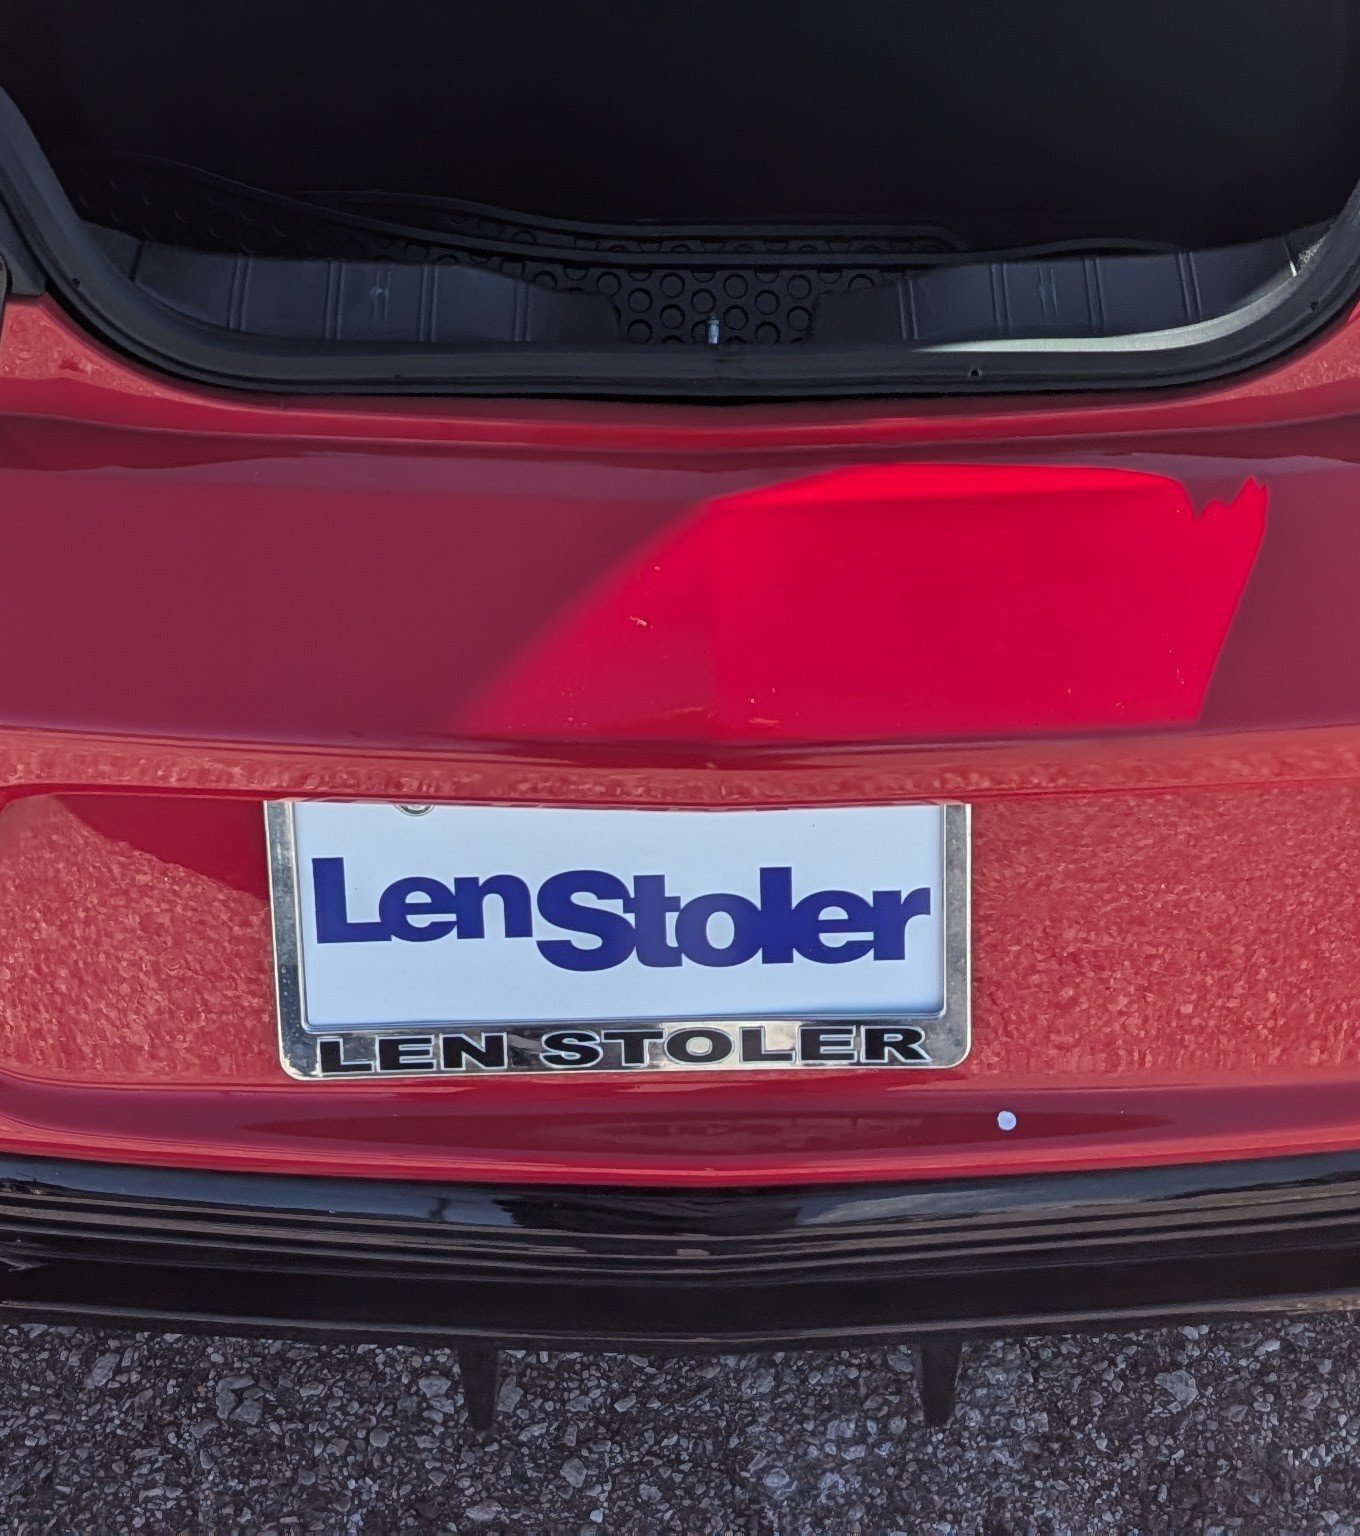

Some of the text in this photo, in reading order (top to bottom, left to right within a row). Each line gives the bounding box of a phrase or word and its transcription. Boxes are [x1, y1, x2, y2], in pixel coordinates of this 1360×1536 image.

[311, 856, 932, 973] LenStoler
[317, 1024, 933, 1076] LEN STOLER
